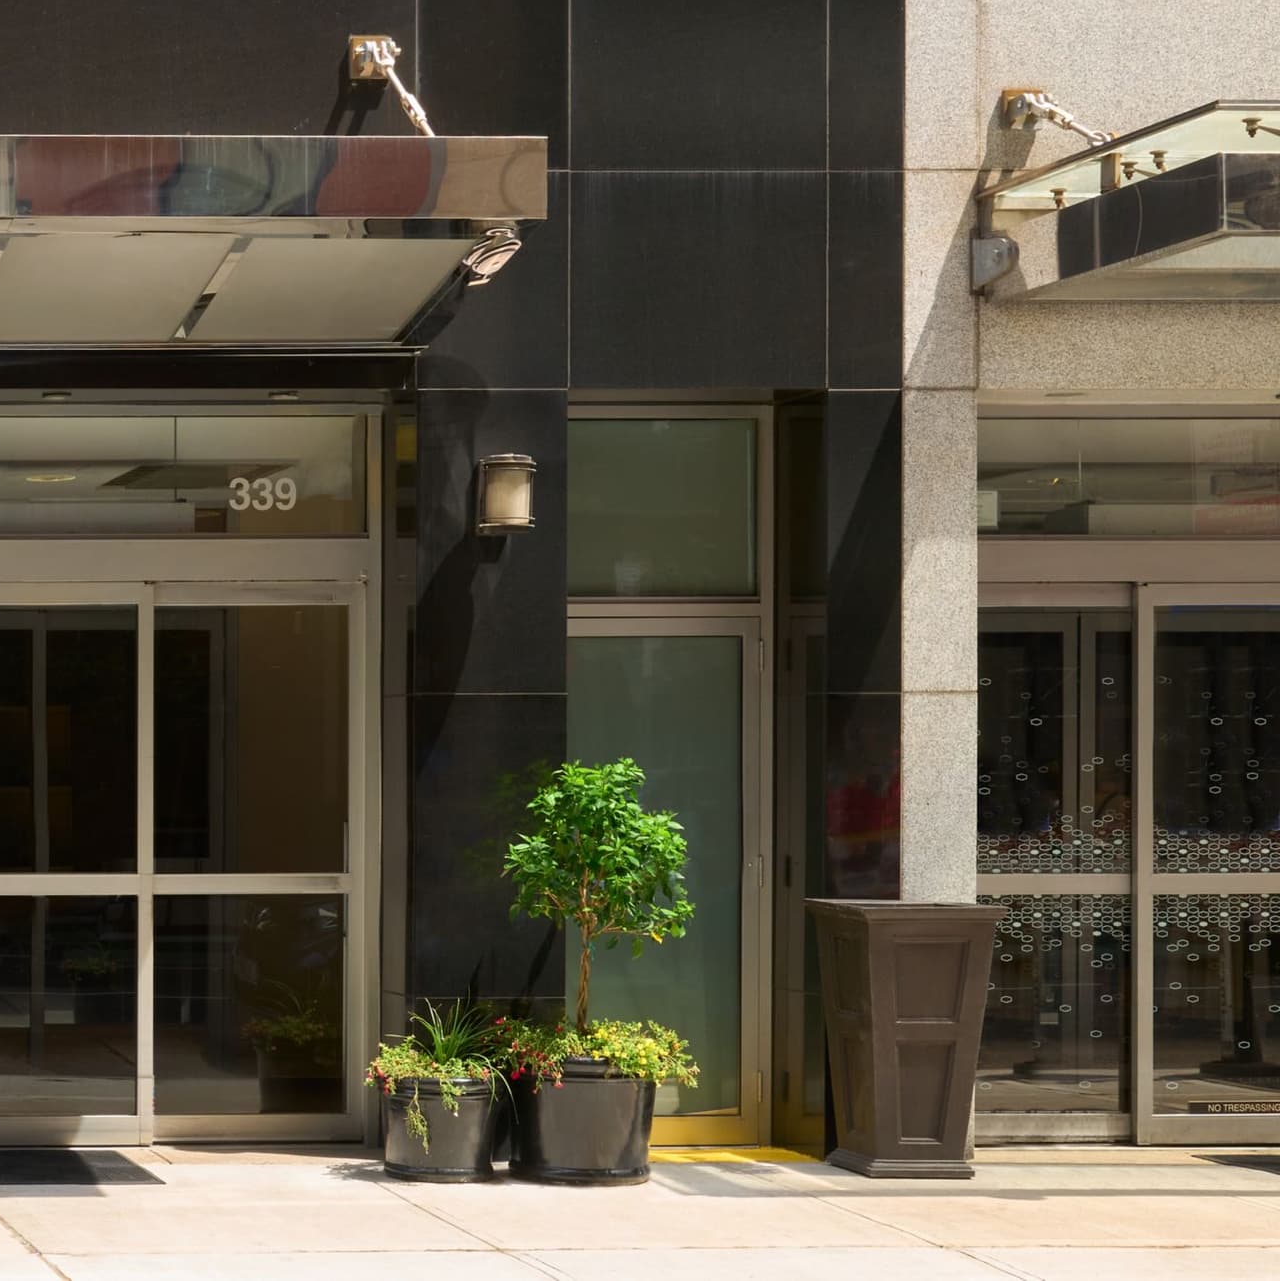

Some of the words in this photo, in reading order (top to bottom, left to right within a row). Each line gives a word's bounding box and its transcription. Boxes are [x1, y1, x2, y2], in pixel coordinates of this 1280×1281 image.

[228, 477, 297, 511] 339
[1207, 1103, 1222, 1113] NO
[1223, 1103, 1280, 1113] TRESPASSING
